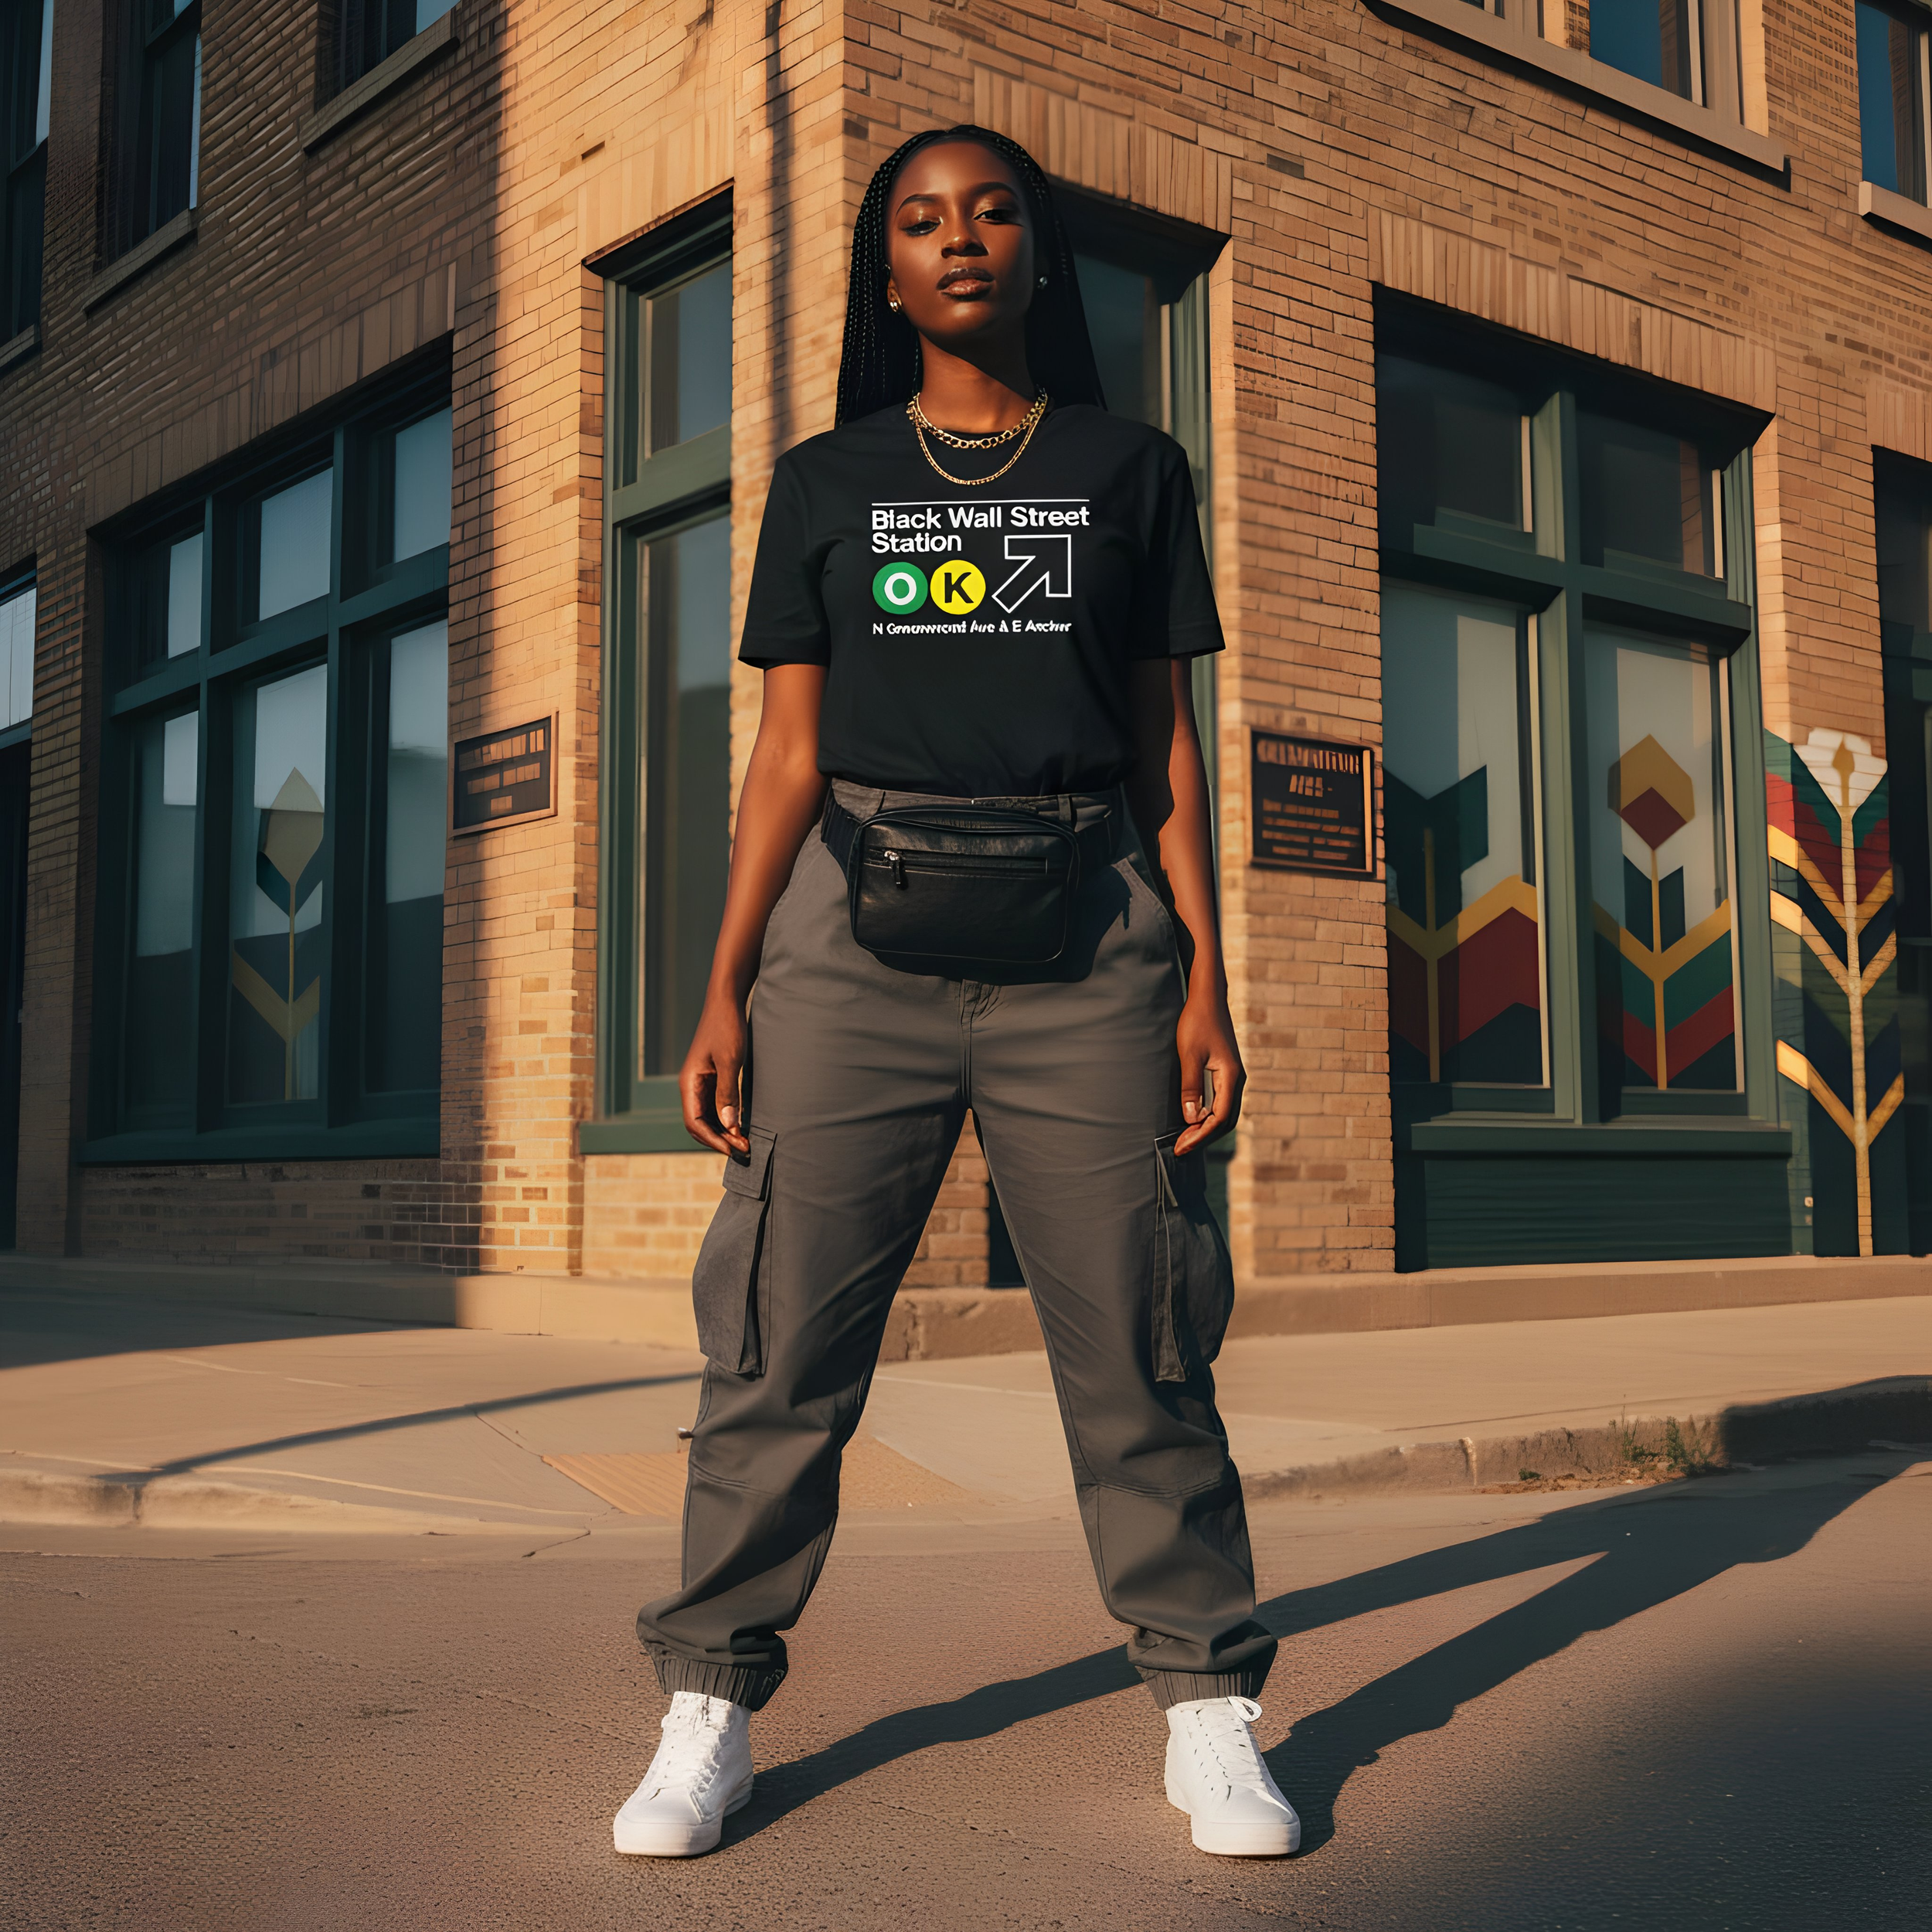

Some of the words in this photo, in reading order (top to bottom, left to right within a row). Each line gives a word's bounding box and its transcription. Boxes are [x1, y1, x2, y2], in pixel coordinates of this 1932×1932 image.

[872, 508, 941, 530] Black
[947, 506, 1002, 528] Wall
[1010, 506, 1090, 527] Street
[872, 532, 962, 553] Station
[872, 622, 883, 634] N
[1012, 620, 1022, 632] E
